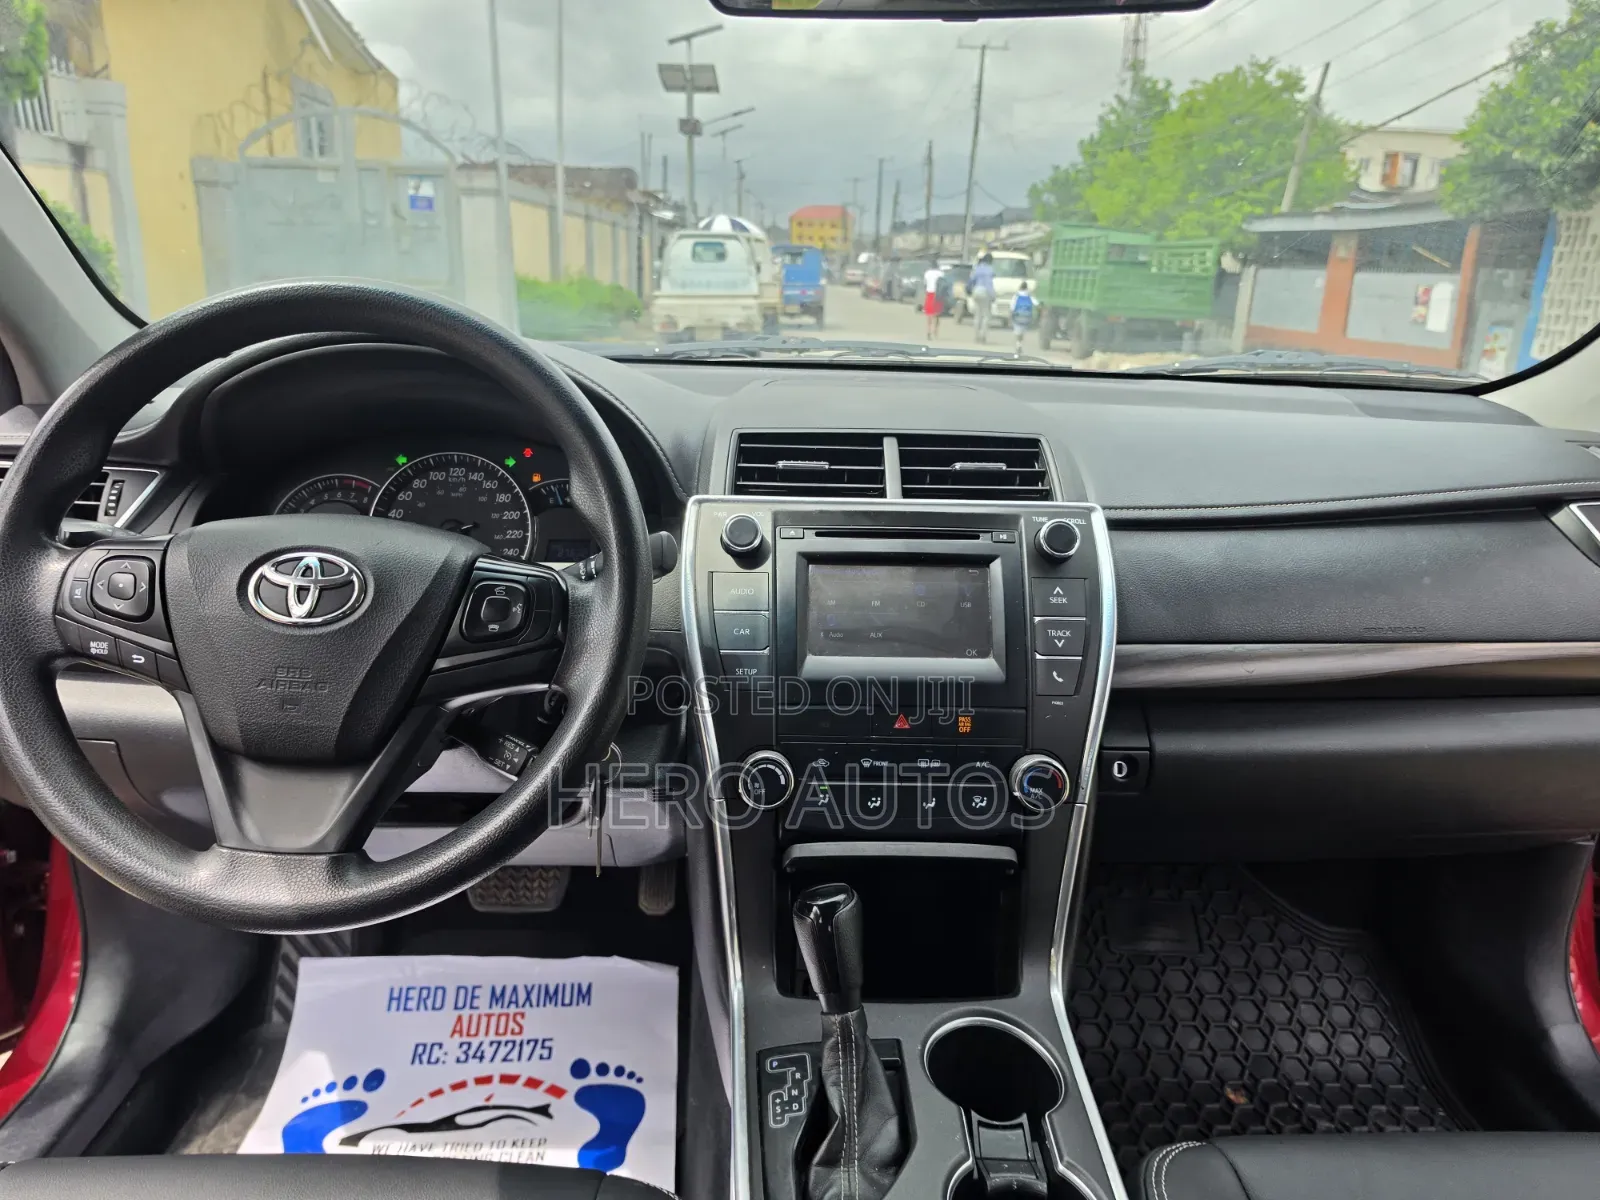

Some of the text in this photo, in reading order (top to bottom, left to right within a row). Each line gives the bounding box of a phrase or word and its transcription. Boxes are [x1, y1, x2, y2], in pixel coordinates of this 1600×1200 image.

[429, 472, 445, 480] 100
[449, 468, 465, 476] 120
[468, 472, 484, 481] 140
[412, 479, 427, 488] 80
[482, 480, 498, 488] 160
[397, 491, 412, 500] 60
[495, 493, 511, 502] 180
[388, 509, 404, 518] 40
[502, 511, 520, 520] 200
[506, 530, 523, 539] 220
[503, 548, 519, 556] 240
[90, 641, 109, 649] MODE
[966, 649, 978, 657] OK
[504, 741, 516, 750] RES
[494, 758, 505, 767] SET
[453, 984, 482, 1010] DE
[489, 982, 593, 1009] MAXIMUM
[450, 1012, 526, 1039] AUTOS
[410, 1038, 554, 1066] RC: 3472175
[398, 1142, 434, 1153] HAVE
[512, 1137, 548, 1148] KEEP
[498, 1151, 545, 1164] CLEAN
